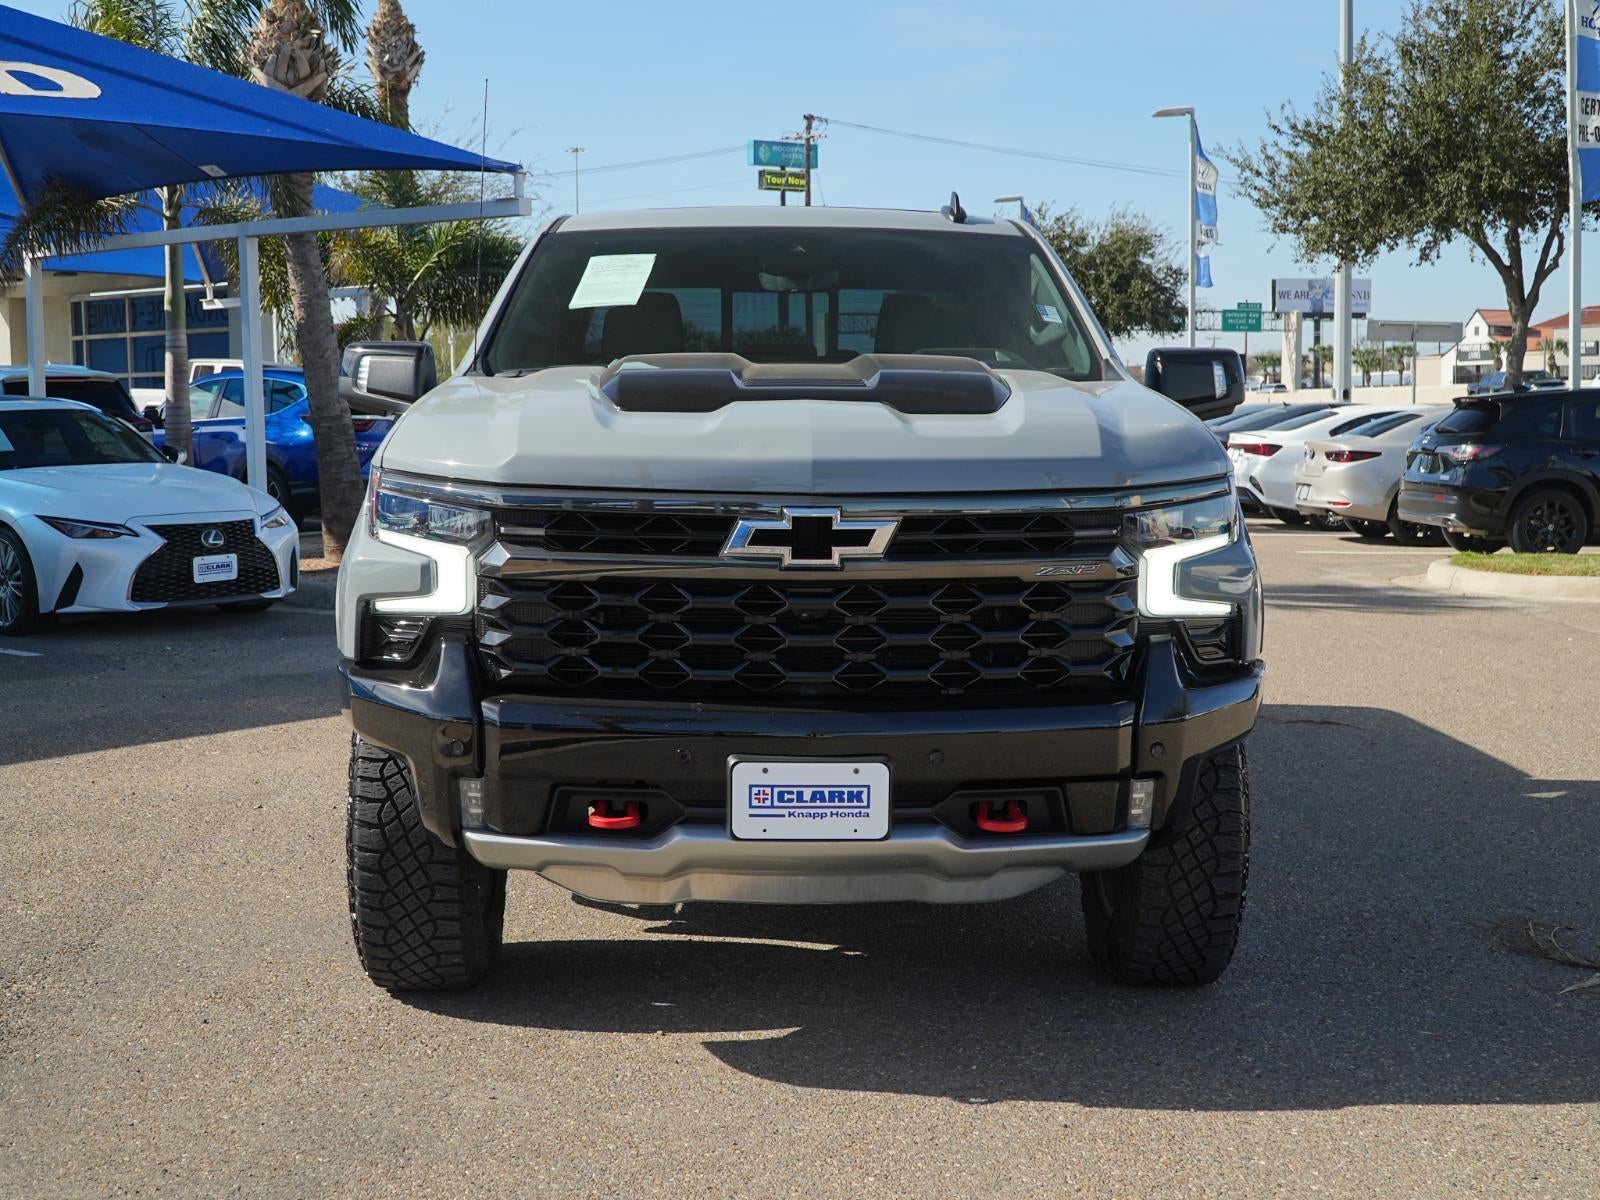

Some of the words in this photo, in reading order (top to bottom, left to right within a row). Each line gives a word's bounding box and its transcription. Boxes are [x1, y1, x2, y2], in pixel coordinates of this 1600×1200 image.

[765, 175, 785, 184] Tour
[1278, 290, 1292, 299] WE
[1293, 290, 1310, 299] ARE
[776, 790, 865, 804] CLARK
[787, 810, 828, 820] Knapp
[830, 810, 870, 819] Honda
